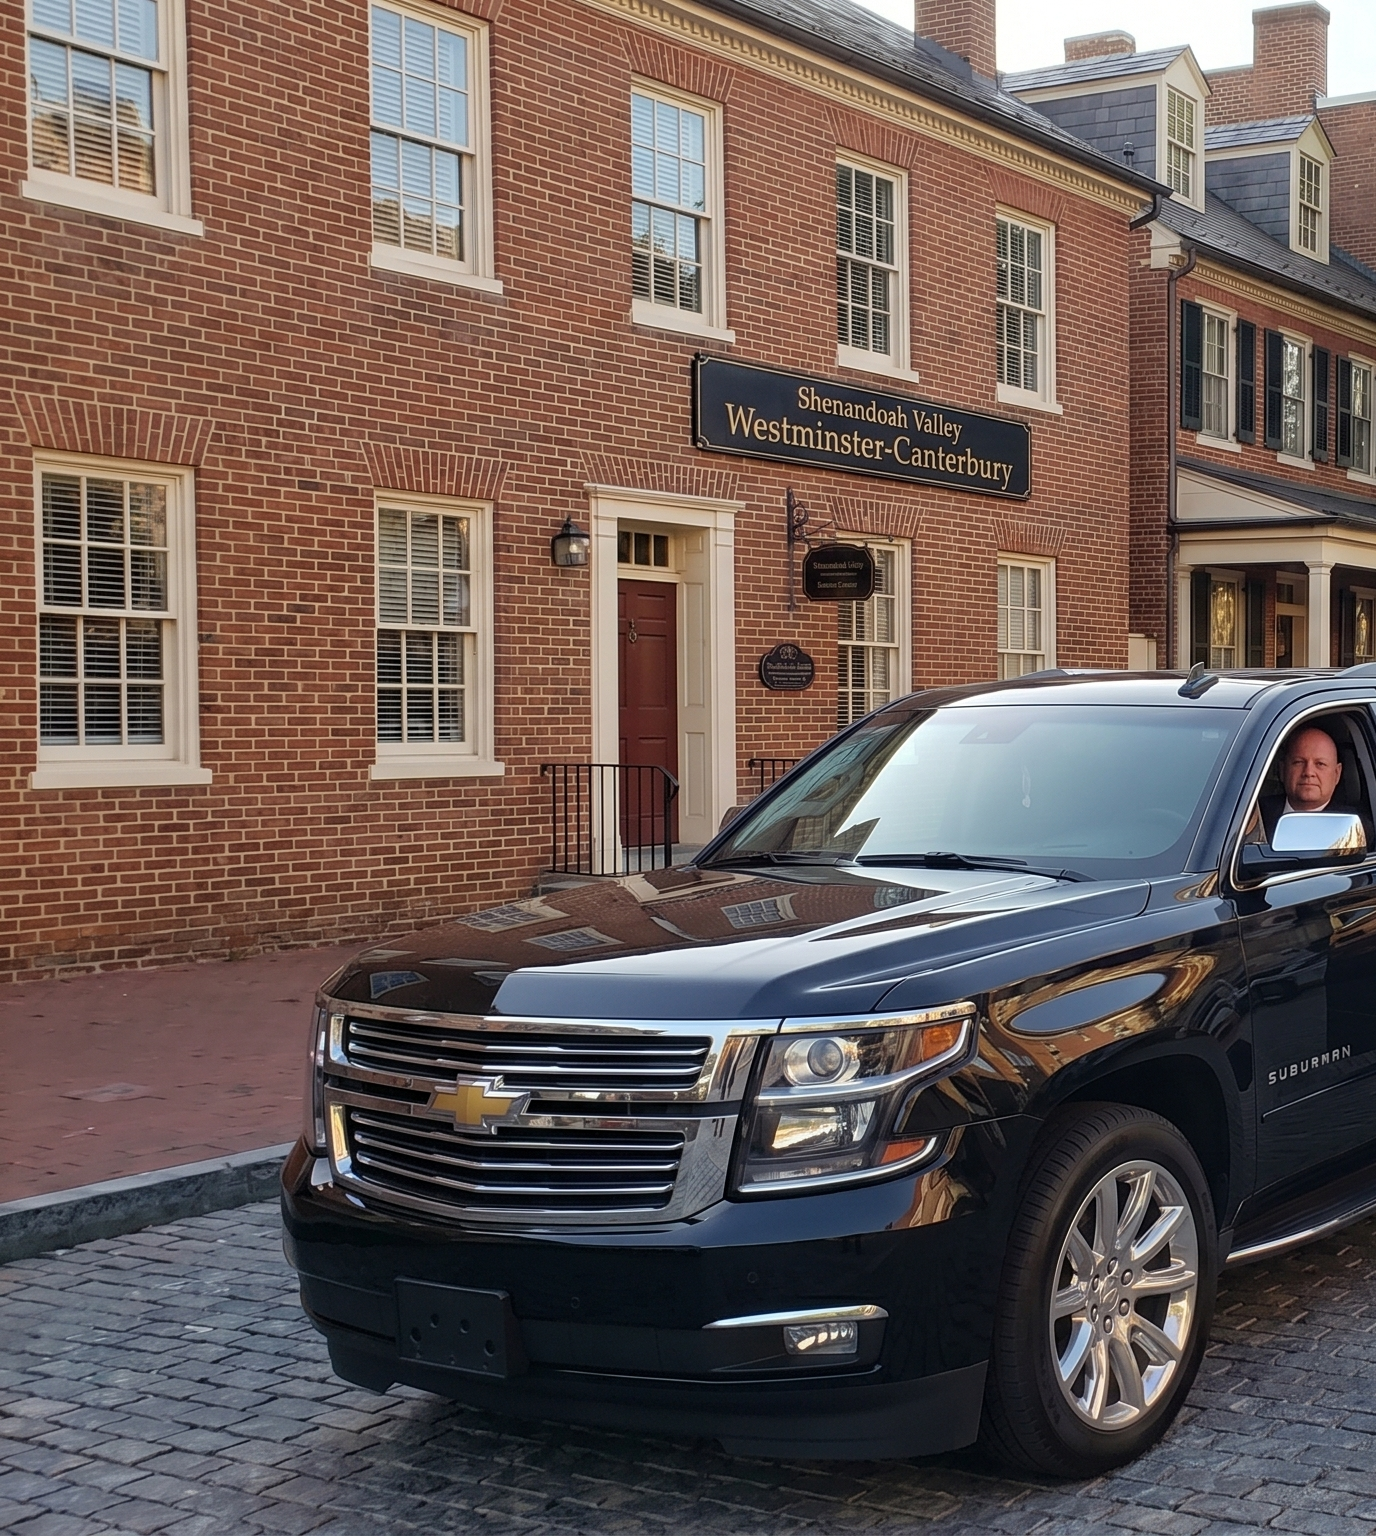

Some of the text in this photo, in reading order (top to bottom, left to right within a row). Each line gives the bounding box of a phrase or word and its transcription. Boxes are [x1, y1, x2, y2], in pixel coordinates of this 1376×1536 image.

[725, 402, 1014, 490] Westminster-Canterbury
[798, 386, 963, 445] Shenandoah Valley
